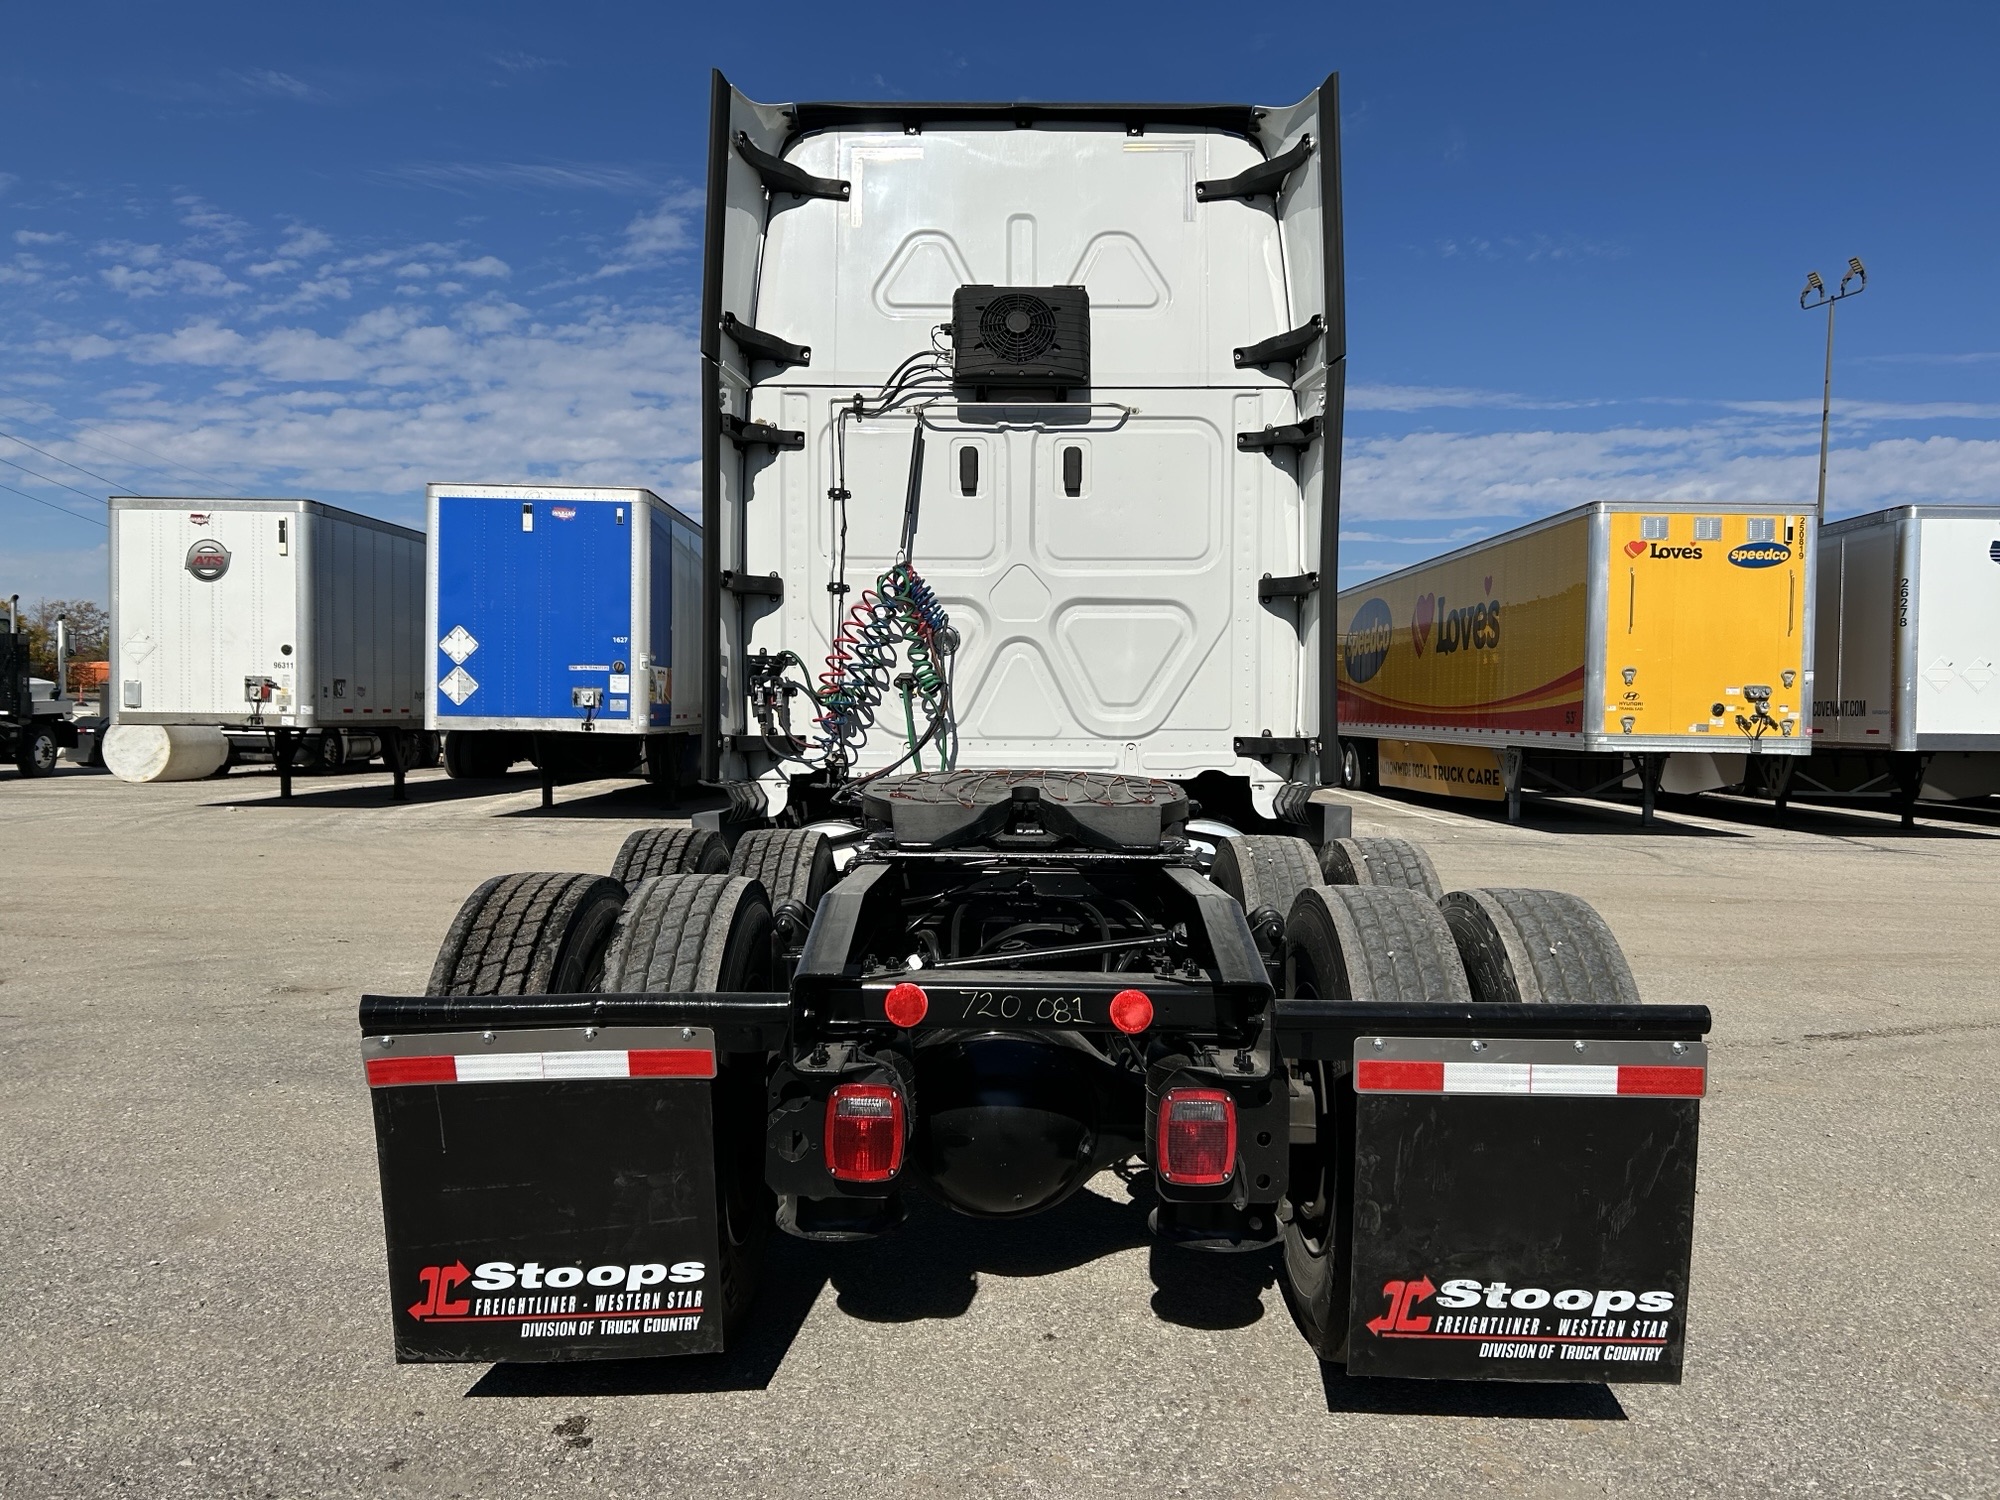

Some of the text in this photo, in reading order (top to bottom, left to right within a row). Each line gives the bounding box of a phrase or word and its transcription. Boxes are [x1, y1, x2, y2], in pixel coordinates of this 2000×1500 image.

[191, 555, 225, 566] ATS
[1730, 548, 1790, 562] speedco
[1899, 578, 1909, 627] 26278
[273, 661, 294, 669] 96311
[1412, 763, 1432, 780] TOTAL
[1432, 764, 1465, 783] TRUCK
[1467, 767, 1500, 786] CARE
[471, 1261, 706, 1292] Stoops
[474, 1295, 577, 1317] FREIGHTLINER
[595, 1291, 661, 1313] WESTERN
[667, 1290, 704, 1309] STAR
[1435, 1279, 1675, 1317] Stoops
[520, 1315, 701, 1339] DIVISION OF TRUCK COUNTRY
[1435, 1315, 1541, 1336] FREIGHTLINER
[1557, 1318, 1626, 1338] WESTERN
[1631, 1320, 1669, 1339] STAR
[1479, 1342, 1663, 1362] DIVISION OF TRUCK COUNTRY
